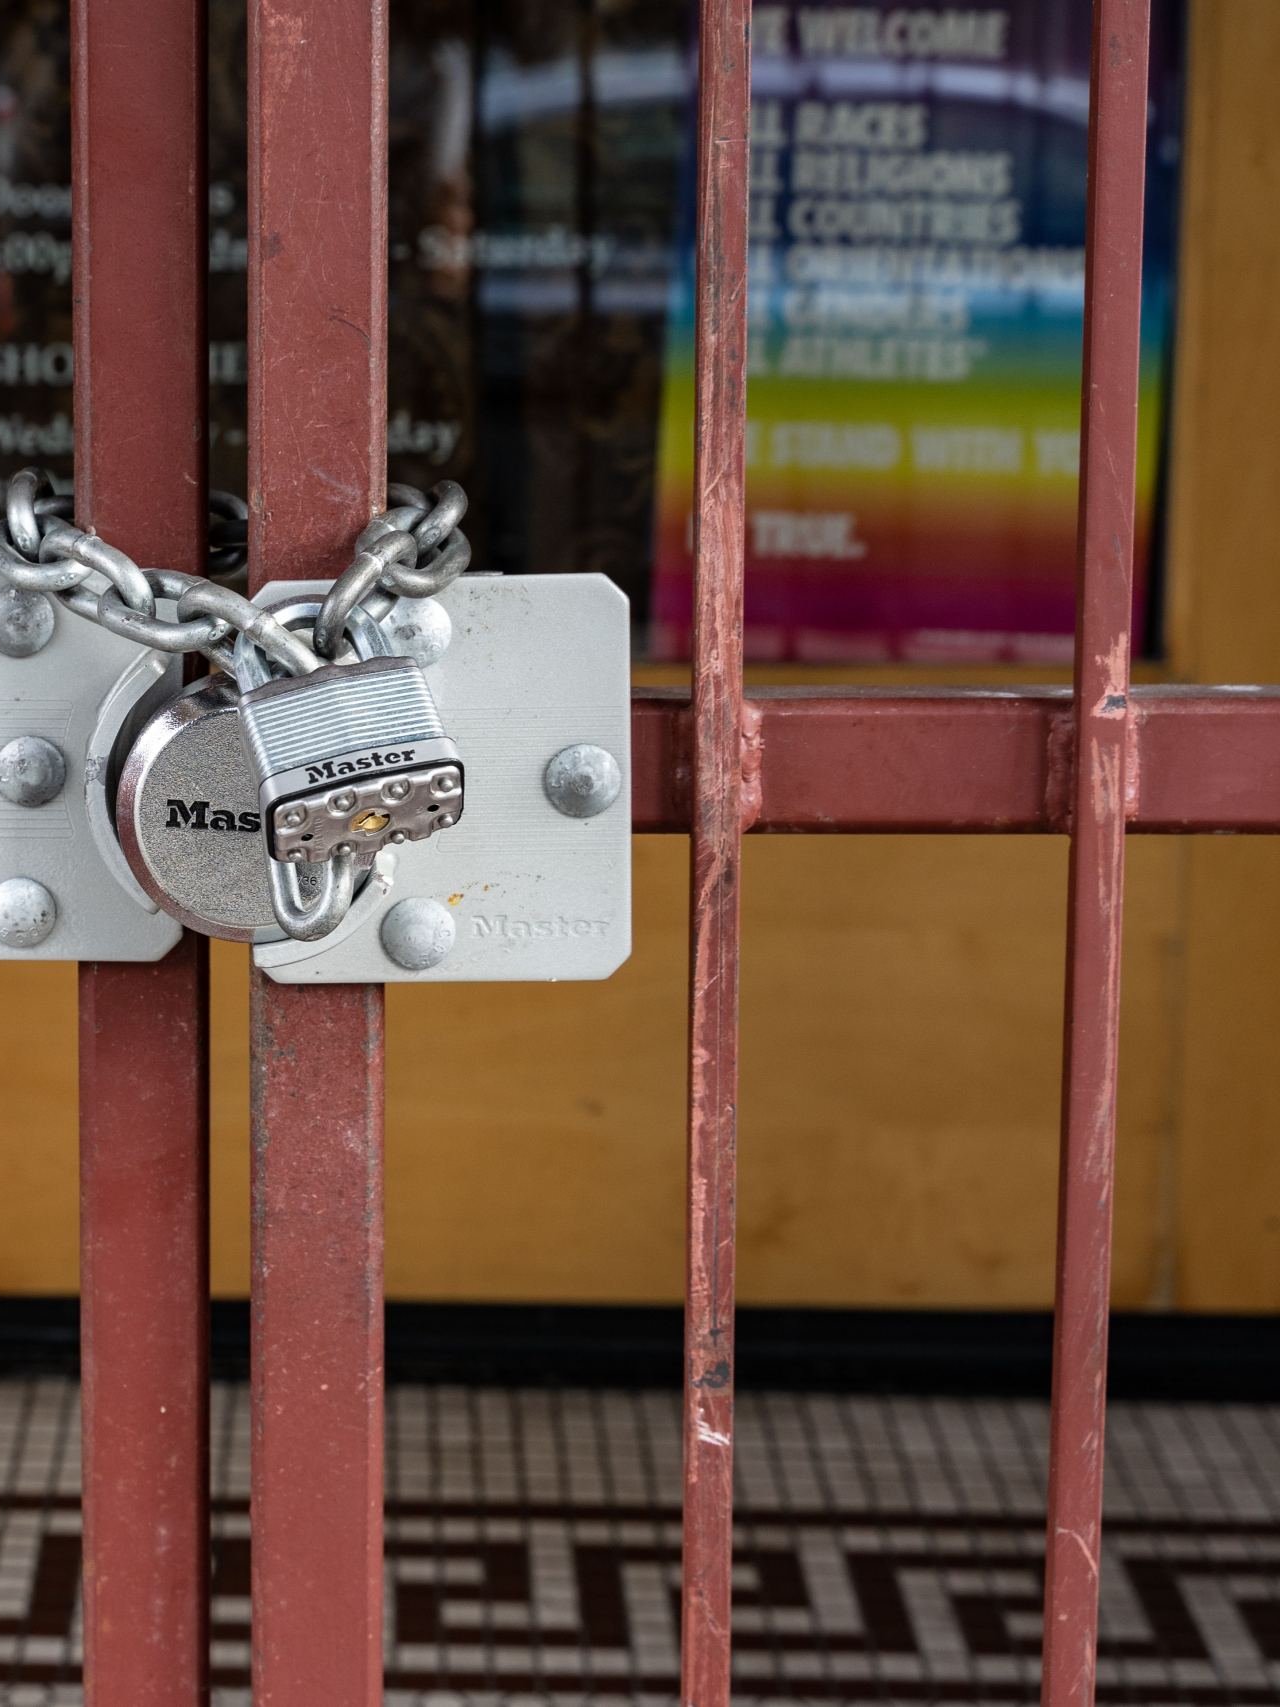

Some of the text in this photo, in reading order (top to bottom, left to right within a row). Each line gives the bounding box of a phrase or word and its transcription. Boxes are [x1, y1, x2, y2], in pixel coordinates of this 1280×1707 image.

[799, 8, 1010, 58] WELCOME
[794, 103, 928, 148] RACES
[791, 151, 1012, 196] RELIGIONS
[787, 201, 1020, 244] COUNTRIES
[304, 748, 416, 785] Master
[165, 798, 261, 833] Mas
[471, 913, 611, 938] Master
